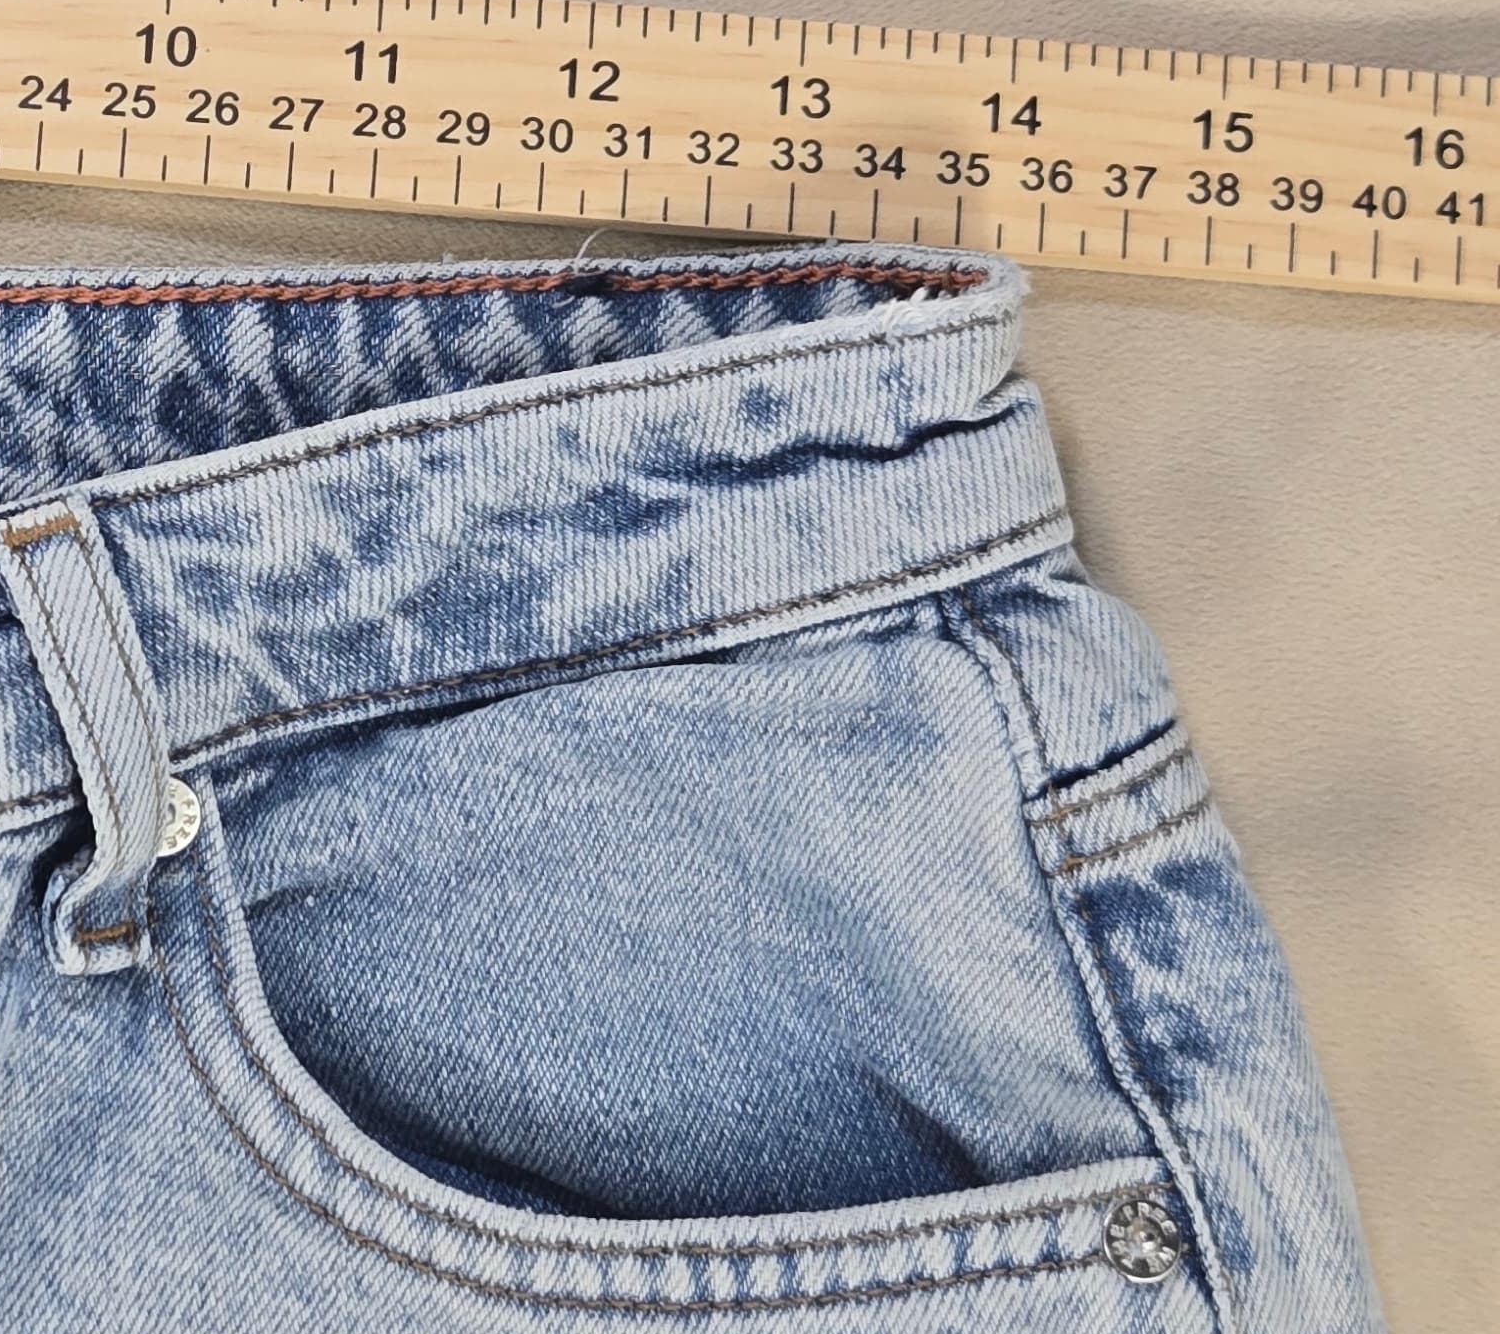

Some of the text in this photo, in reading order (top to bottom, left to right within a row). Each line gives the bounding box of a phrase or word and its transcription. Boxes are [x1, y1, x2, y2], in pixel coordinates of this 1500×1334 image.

[17, 74, 73, 113] 24
[101, 81, 157, 119] 25
[185, 88, 240, 127] 26
[268, 95, 325, 133] 27
[351, 102, 407, 140] 28
[435, 109, 491, 147] 29
[520, 116, 574, 154] 30
[603, 122, 652, 160] 31
[687, 129, 740, 168] 32
[769, 136, 824, 174] 33
[853, 143, 907, 181] 34
[936, 149, 991, 188] 35
[1019, 156, 1074, 194] 36
[1103, 163, 1158, 200] 37
[1186, 170, 1240, 207] 38
[1269, 176, 1324, 214] 39
[1351, 183, 1408, 221] 40
[1435, 190, 1485, 227] 41
[135, 22, 197, 68] 10
[344, 39, 399, 85] 11
[558, 57, 621, 103] 12
[770, 74, 831, 120] 13
[981, 91, 1042, 137] 14
[1192, 108, 1254, 154] 15
[1404, 126, 1466, 170] 16
